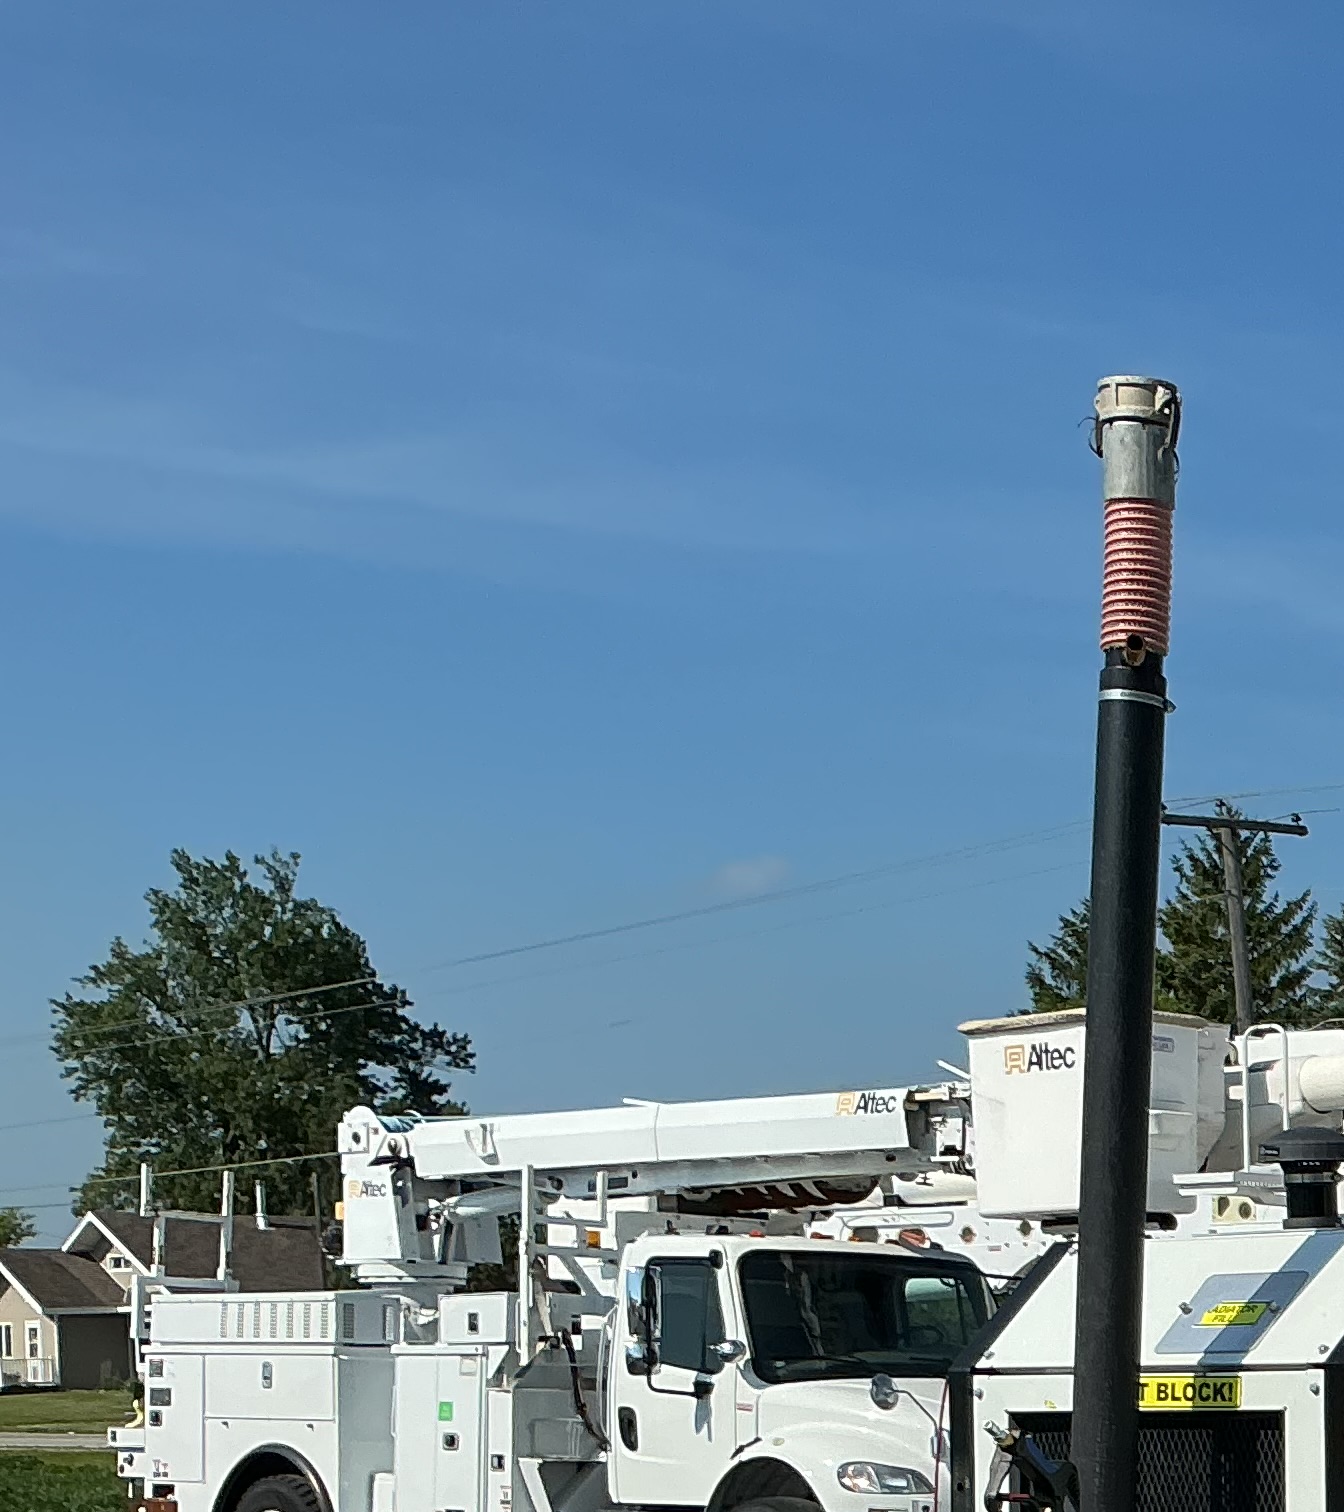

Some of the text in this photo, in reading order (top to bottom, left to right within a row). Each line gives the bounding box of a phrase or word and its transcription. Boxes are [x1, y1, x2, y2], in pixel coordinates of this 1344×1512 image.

[1027, 1042, 1075, 1072] Altec
[853, 1092, 897, 1115] Altec
[1156, 1382, 1234, 1402] BLOCK!
